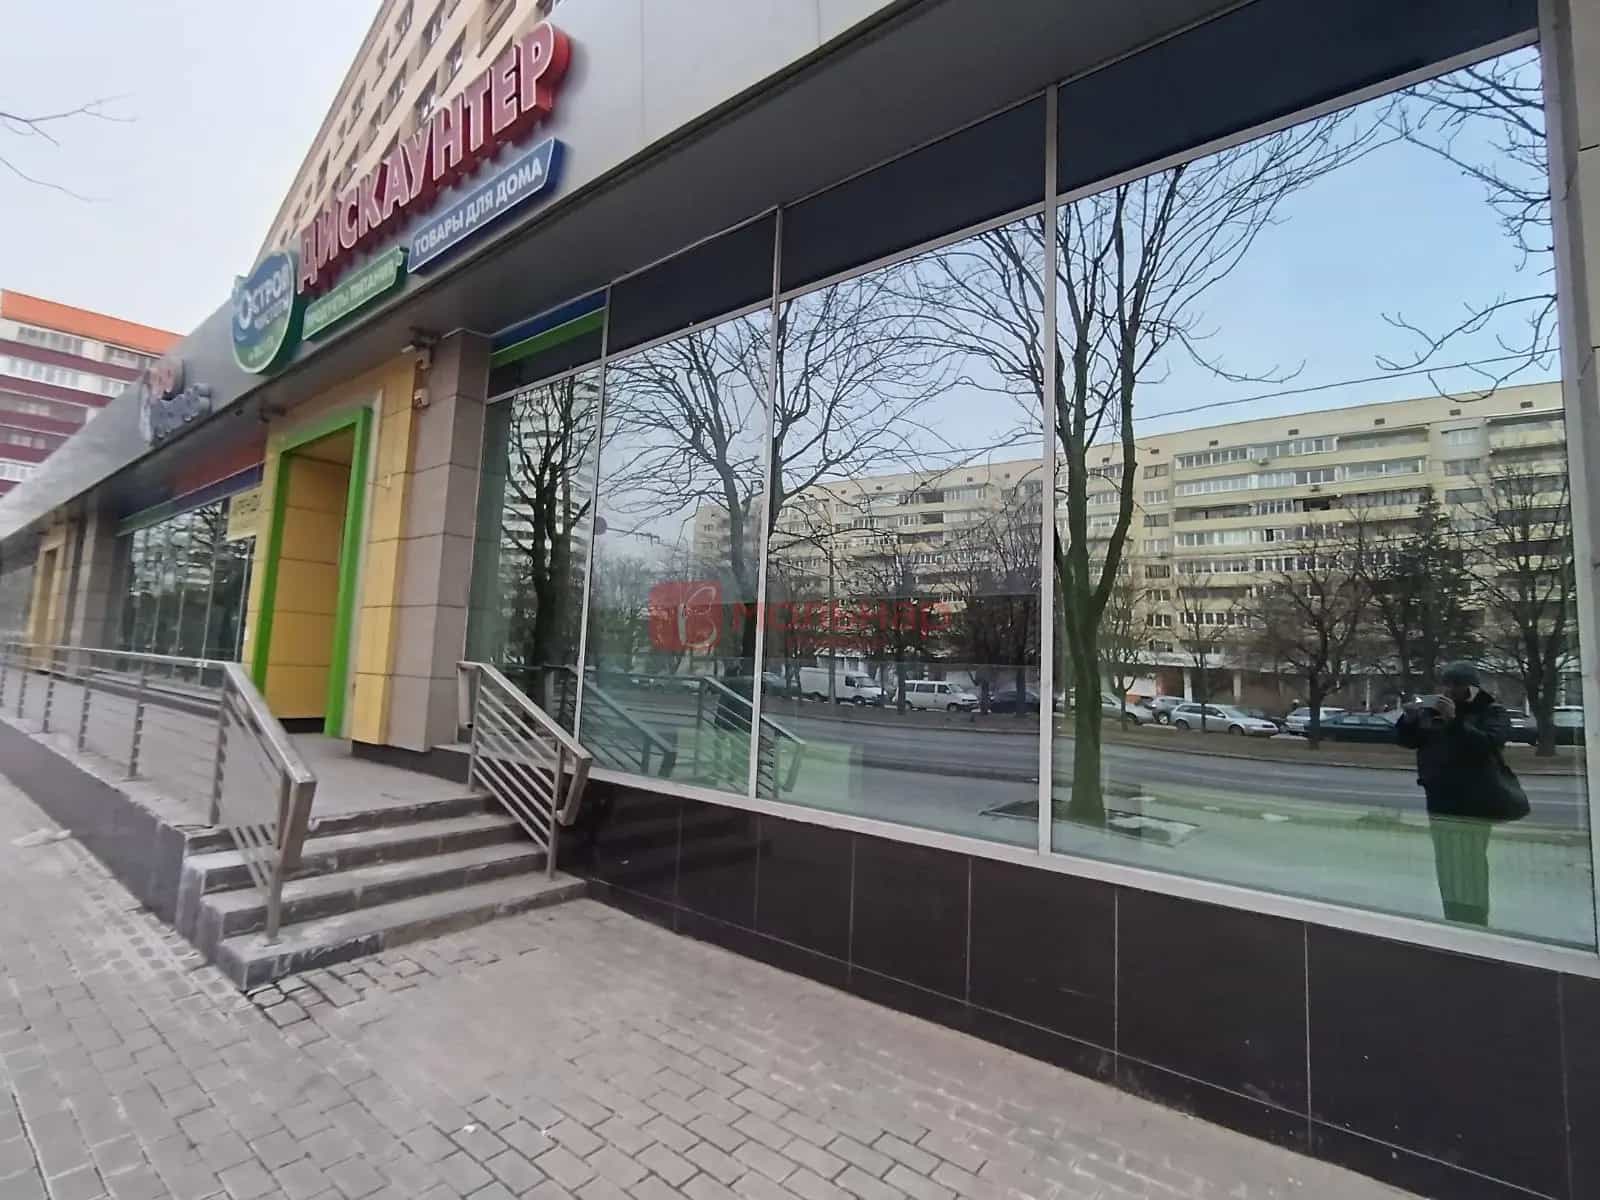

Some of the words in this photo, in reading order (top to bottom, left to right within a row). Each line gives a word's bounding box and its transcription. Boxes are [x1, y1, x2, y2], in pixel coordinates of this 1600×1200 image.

[297, 20, 560, 294] ДИСКАУНТЕР
[414, 209, 464, 257] ТОВАРЫ
[465, 189, 494, 228] ДЛЯ
[495, 157, 543, 208] ДОМА
